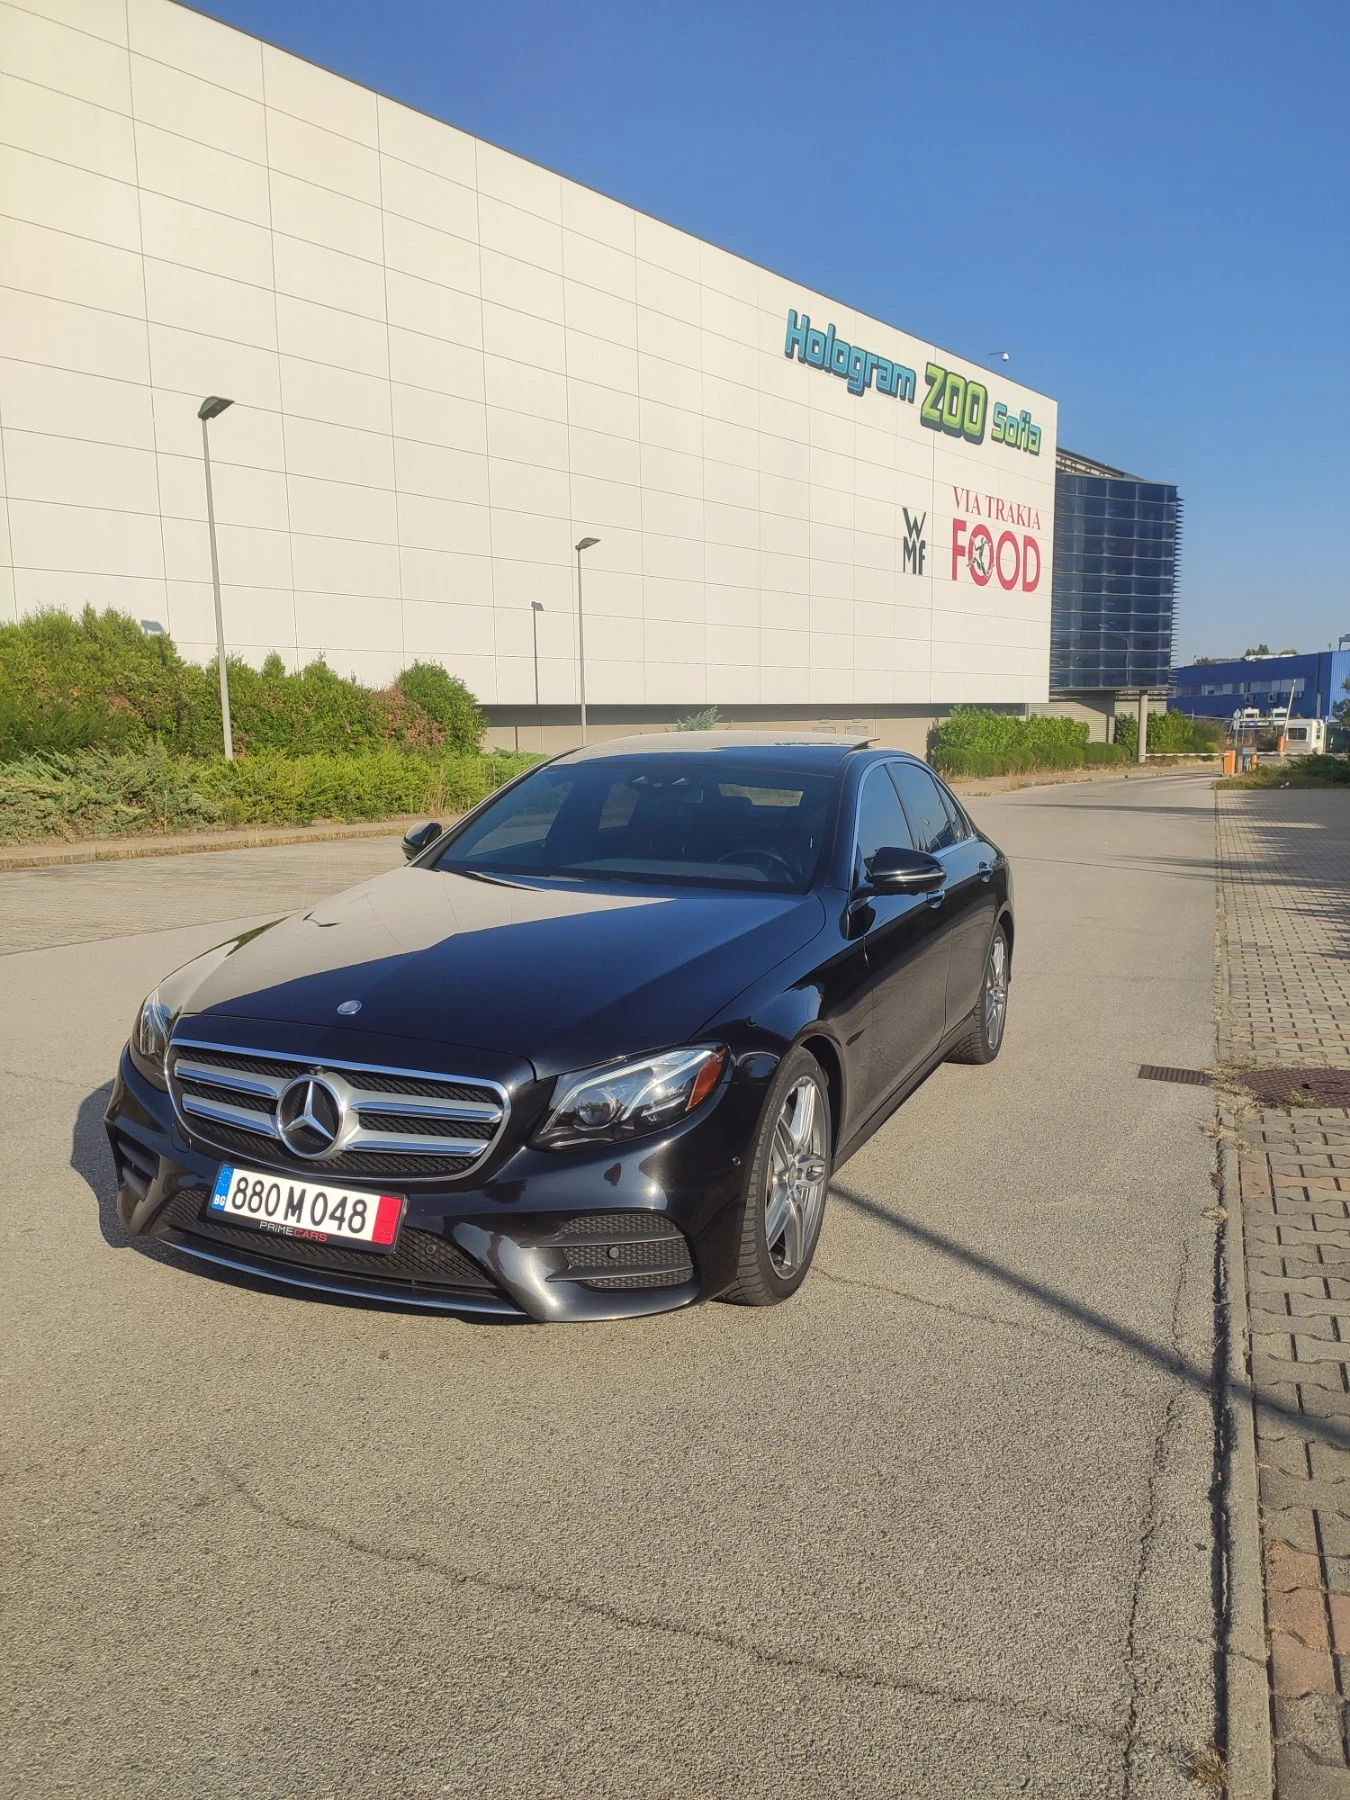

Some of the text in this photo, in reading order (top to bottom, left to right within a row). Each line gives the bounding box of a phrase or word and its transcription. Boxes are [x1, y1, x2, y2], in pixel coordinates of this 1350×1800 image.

[785, 308, 1042, 456] Hologram ZOO Sofia
[952, 486, 1041, 530] VIA TRAKIA
[952, 517, 1041, 592] FOOD
[213, 1193, 227, 1206] BG
